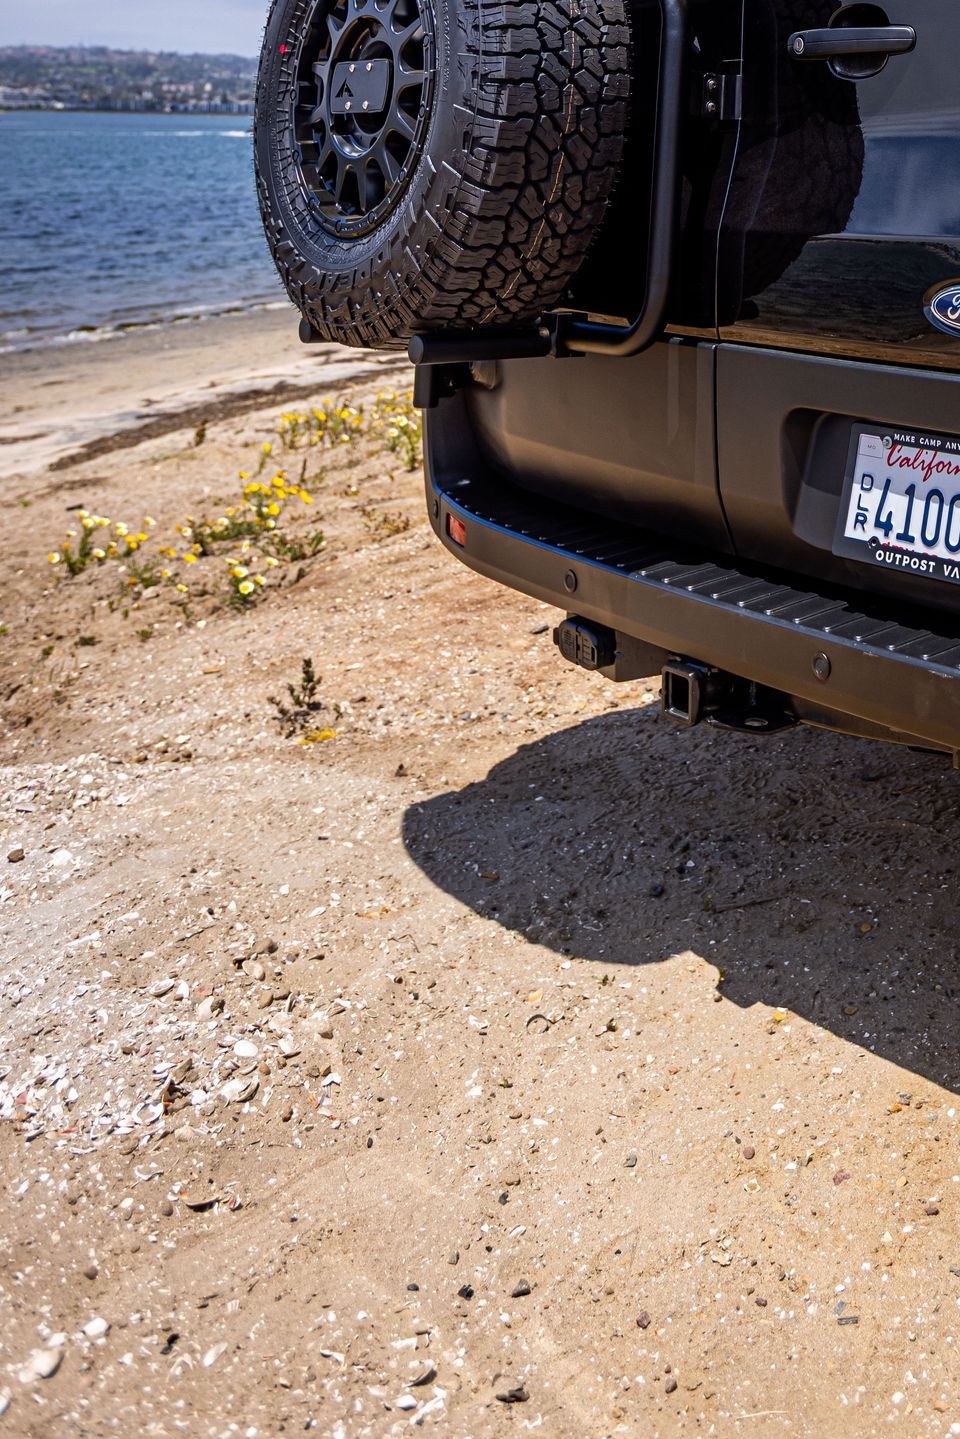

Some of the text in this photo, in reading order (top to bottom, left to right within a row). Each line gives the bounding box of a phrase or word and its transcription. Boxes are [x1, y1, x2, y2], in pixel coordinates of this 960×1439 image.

[893, 433, 916, 443] MAKE
[919, 437, 942, 448] CAMP
[875, 550, 936, 573] OUTPOST
